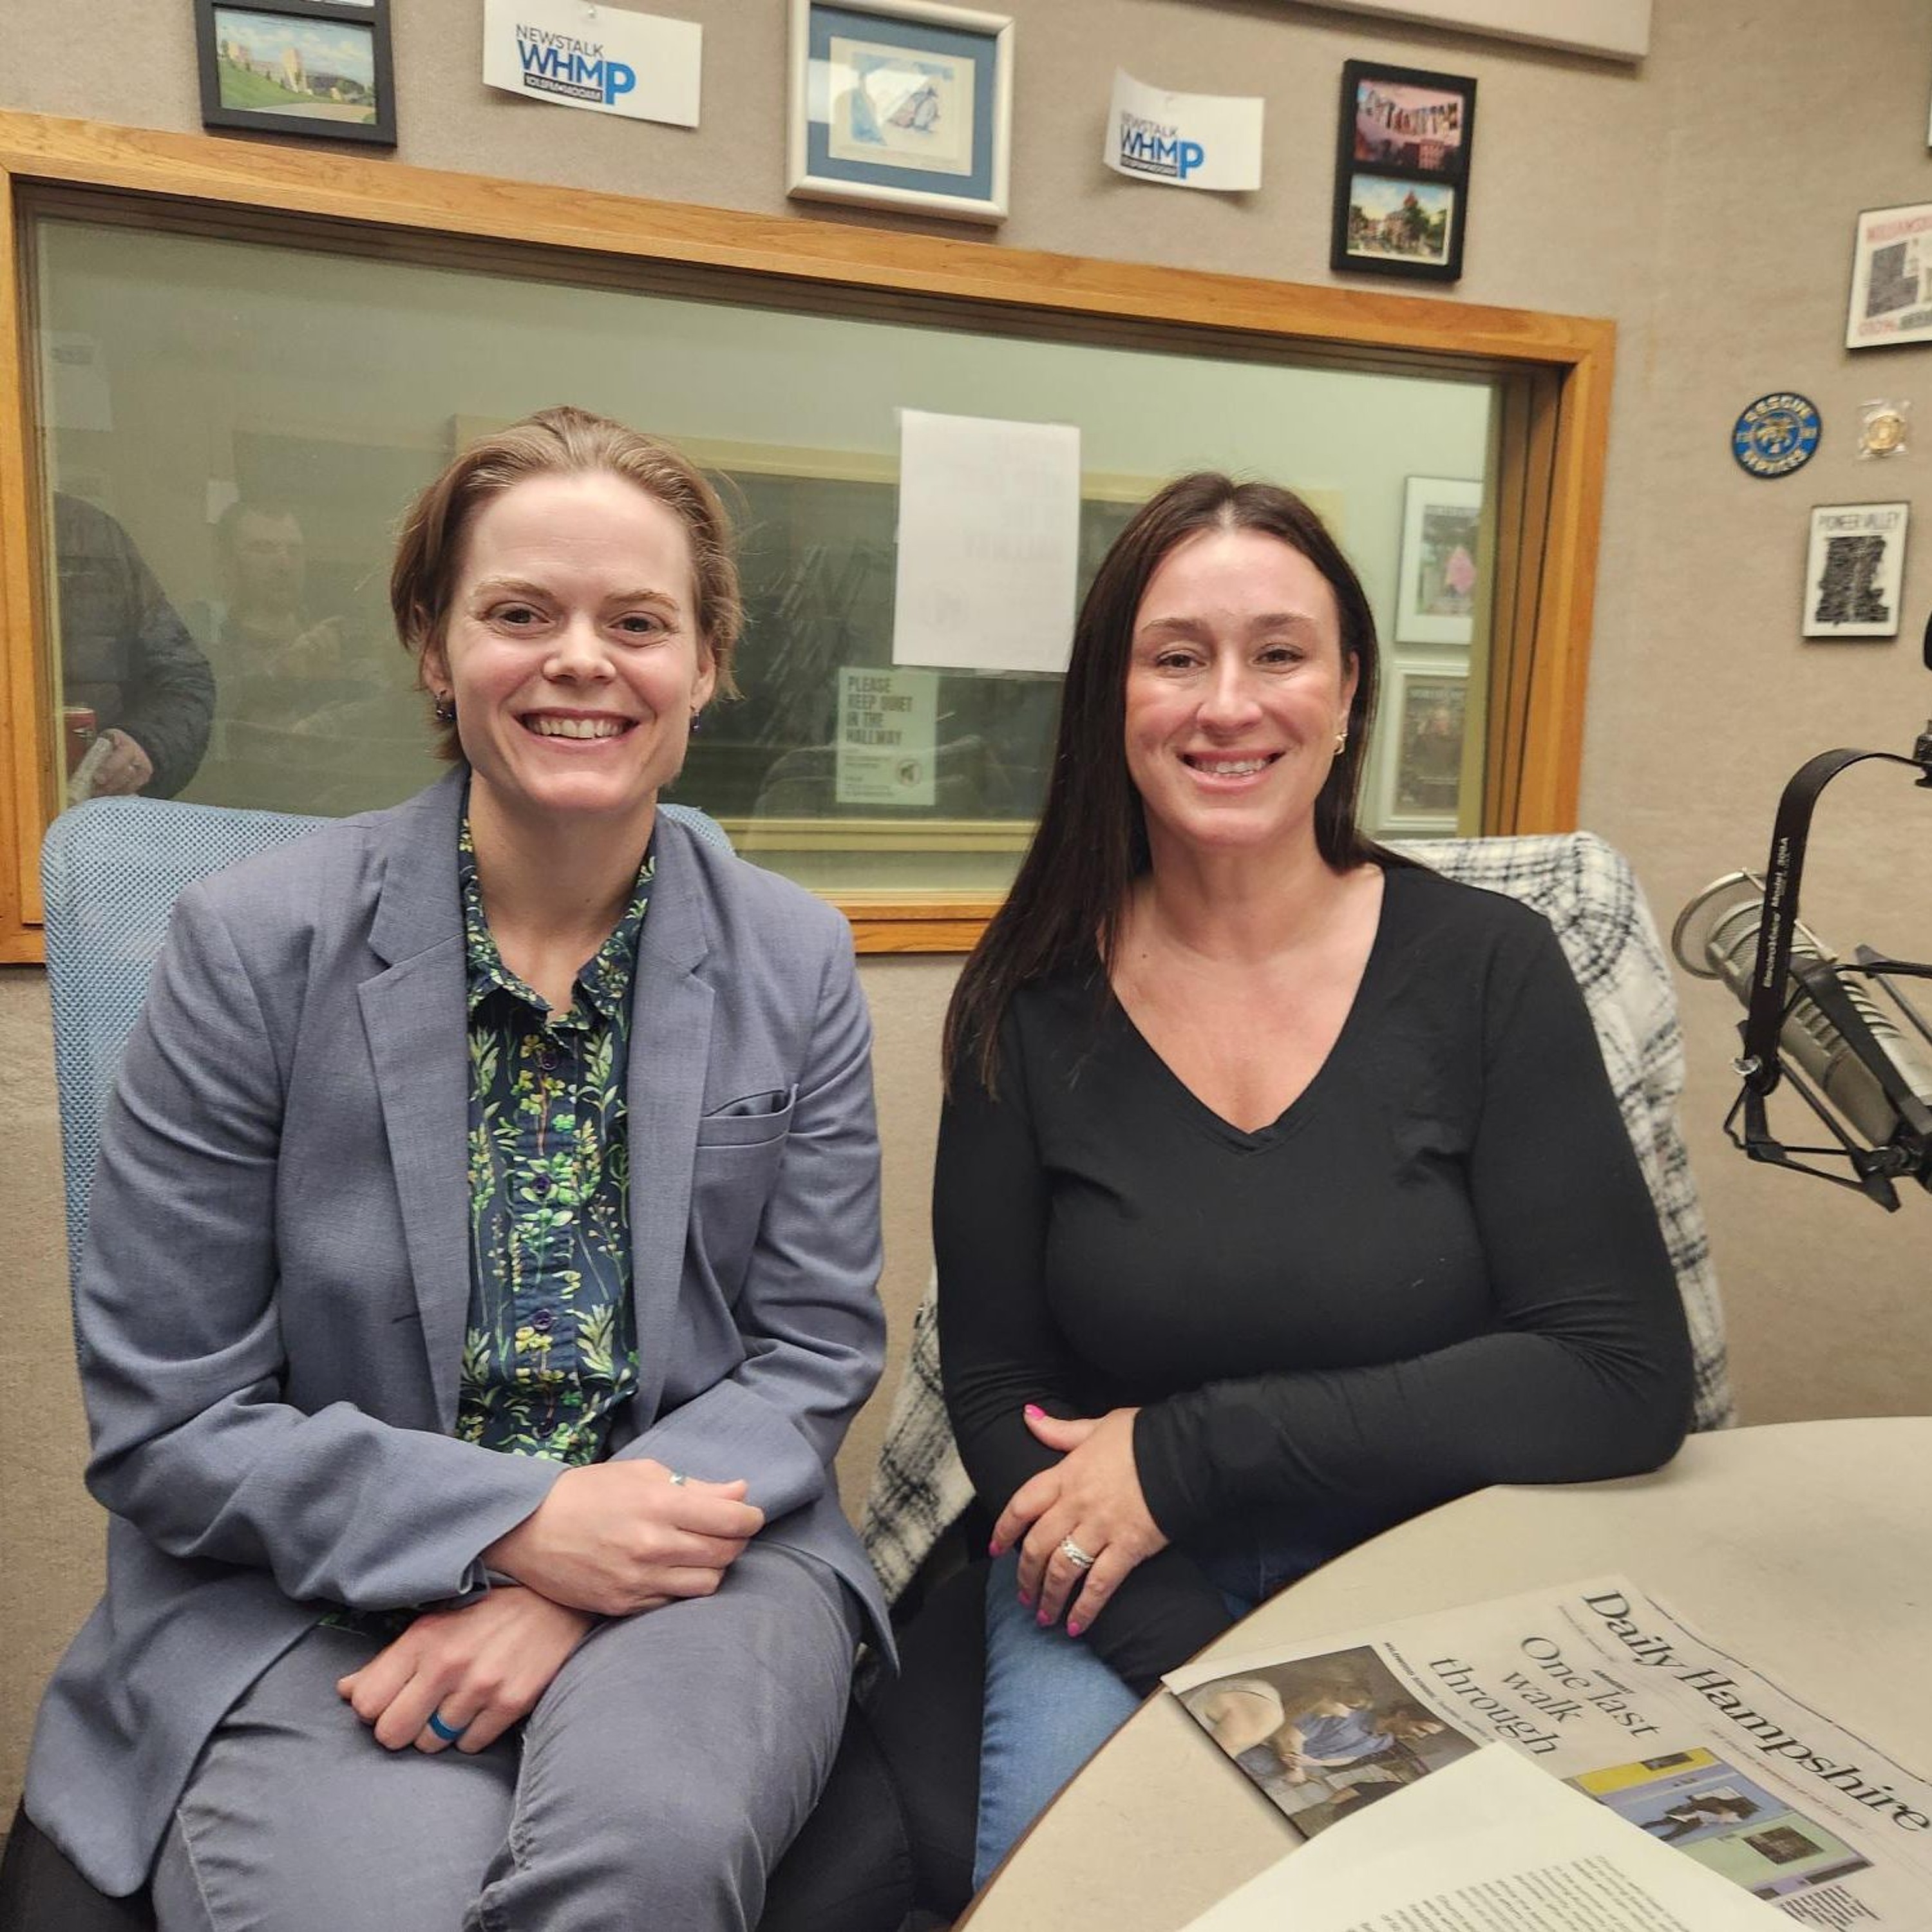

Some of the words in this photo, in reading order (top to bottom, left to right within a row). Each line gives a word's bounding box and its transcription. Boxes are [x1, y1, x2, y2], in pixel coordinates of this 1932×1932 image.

[516, 24, 604, 59] NEWSTALK
[517, 40, 636, 105] WHMP
[1121, 124, 1204, 179] WHMP
[848, 676, 891, 693] PLEASE
[1428, 1657, 1562, 1755] through
[1502, 1671, 1584, 1723] walk
[1520, 1637, 1591, 1690] One
[1588, 1690, 1663, 1738] last
[1582, 1589, 1688, 1668] Daily
[1672, 1668, 1930, 1832] Hampshire
